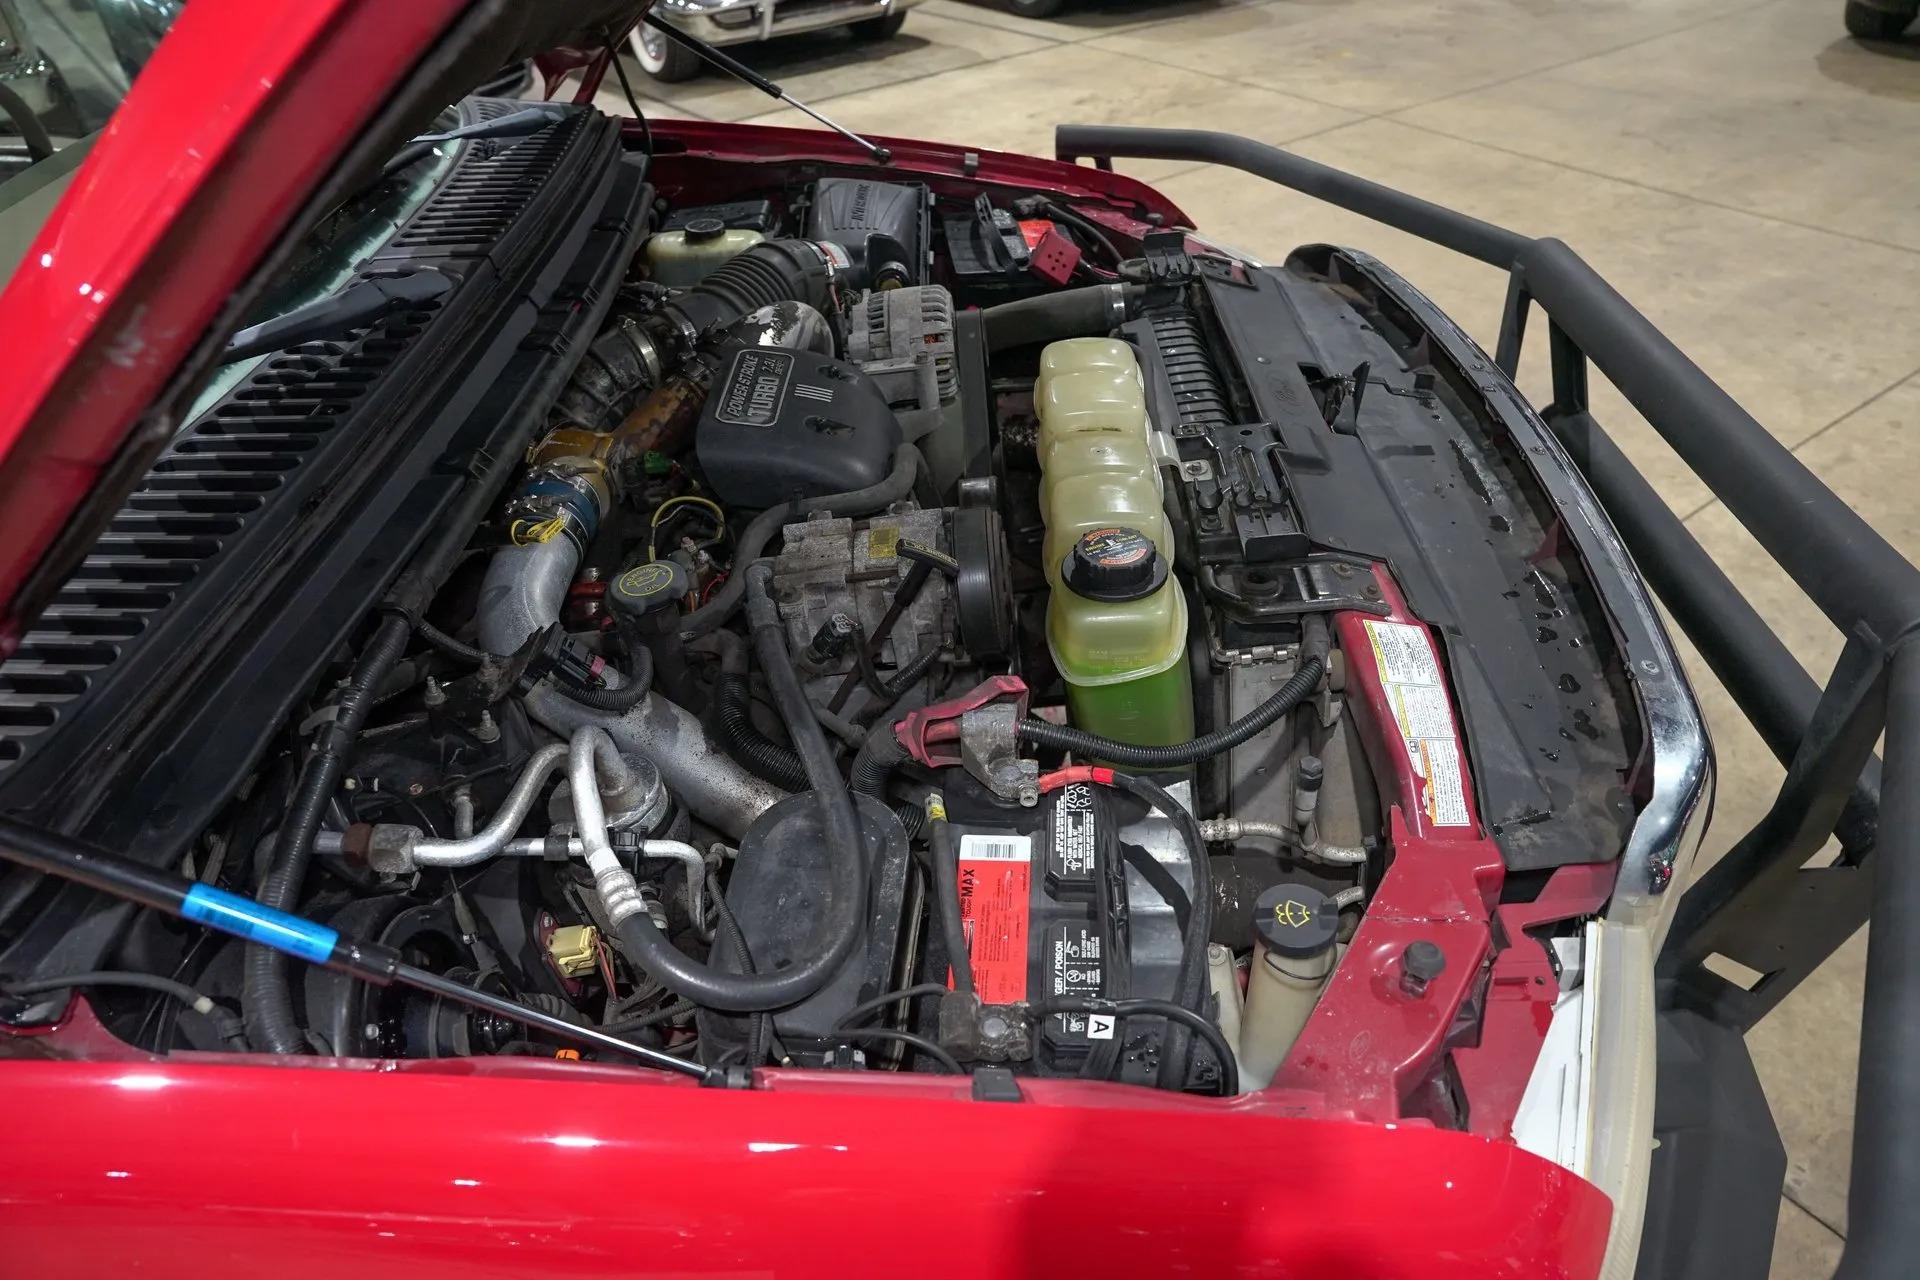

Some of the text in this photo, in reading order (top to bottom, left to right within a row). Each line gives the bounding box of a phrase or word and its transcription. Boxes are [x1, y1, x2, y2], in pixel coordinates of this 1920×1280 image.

[726, 354, 758, 416] POWER STROKE
[747, 376, 780, 416] TURBO
[961, 869, 974, 897] MAX
[1055, 940, 1063, 969] POISON
[1054, 977, 1063, 995] GER
[1094, 1021, 1109, 1033] A
